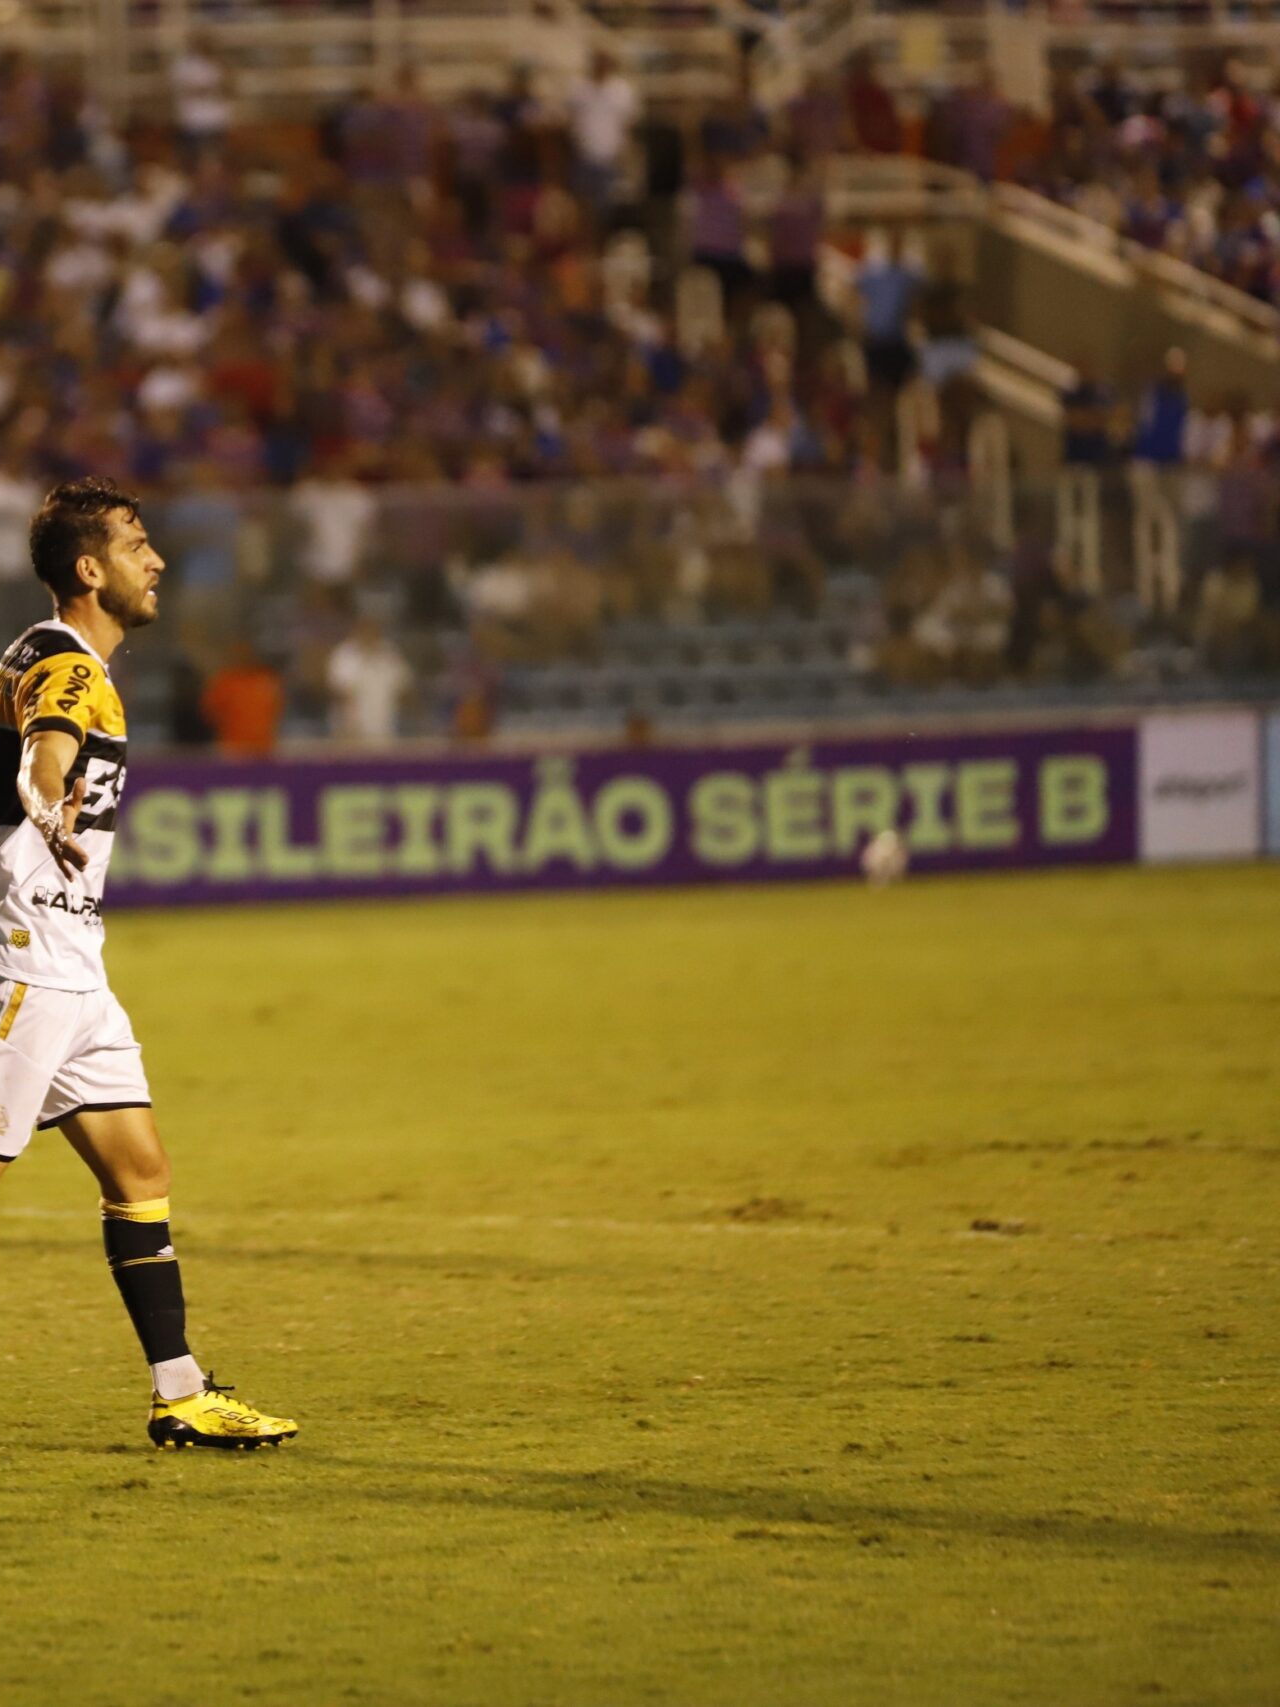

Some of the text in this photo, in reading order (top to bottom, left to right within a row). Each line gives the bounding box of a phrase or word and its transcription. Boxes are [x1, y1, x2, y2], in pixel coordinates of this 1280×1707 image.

[56, 663, 91, 714] ANJO
[690, 745, 1018, 866] SÉRIE
[1040, 754, 1109, 844] B
